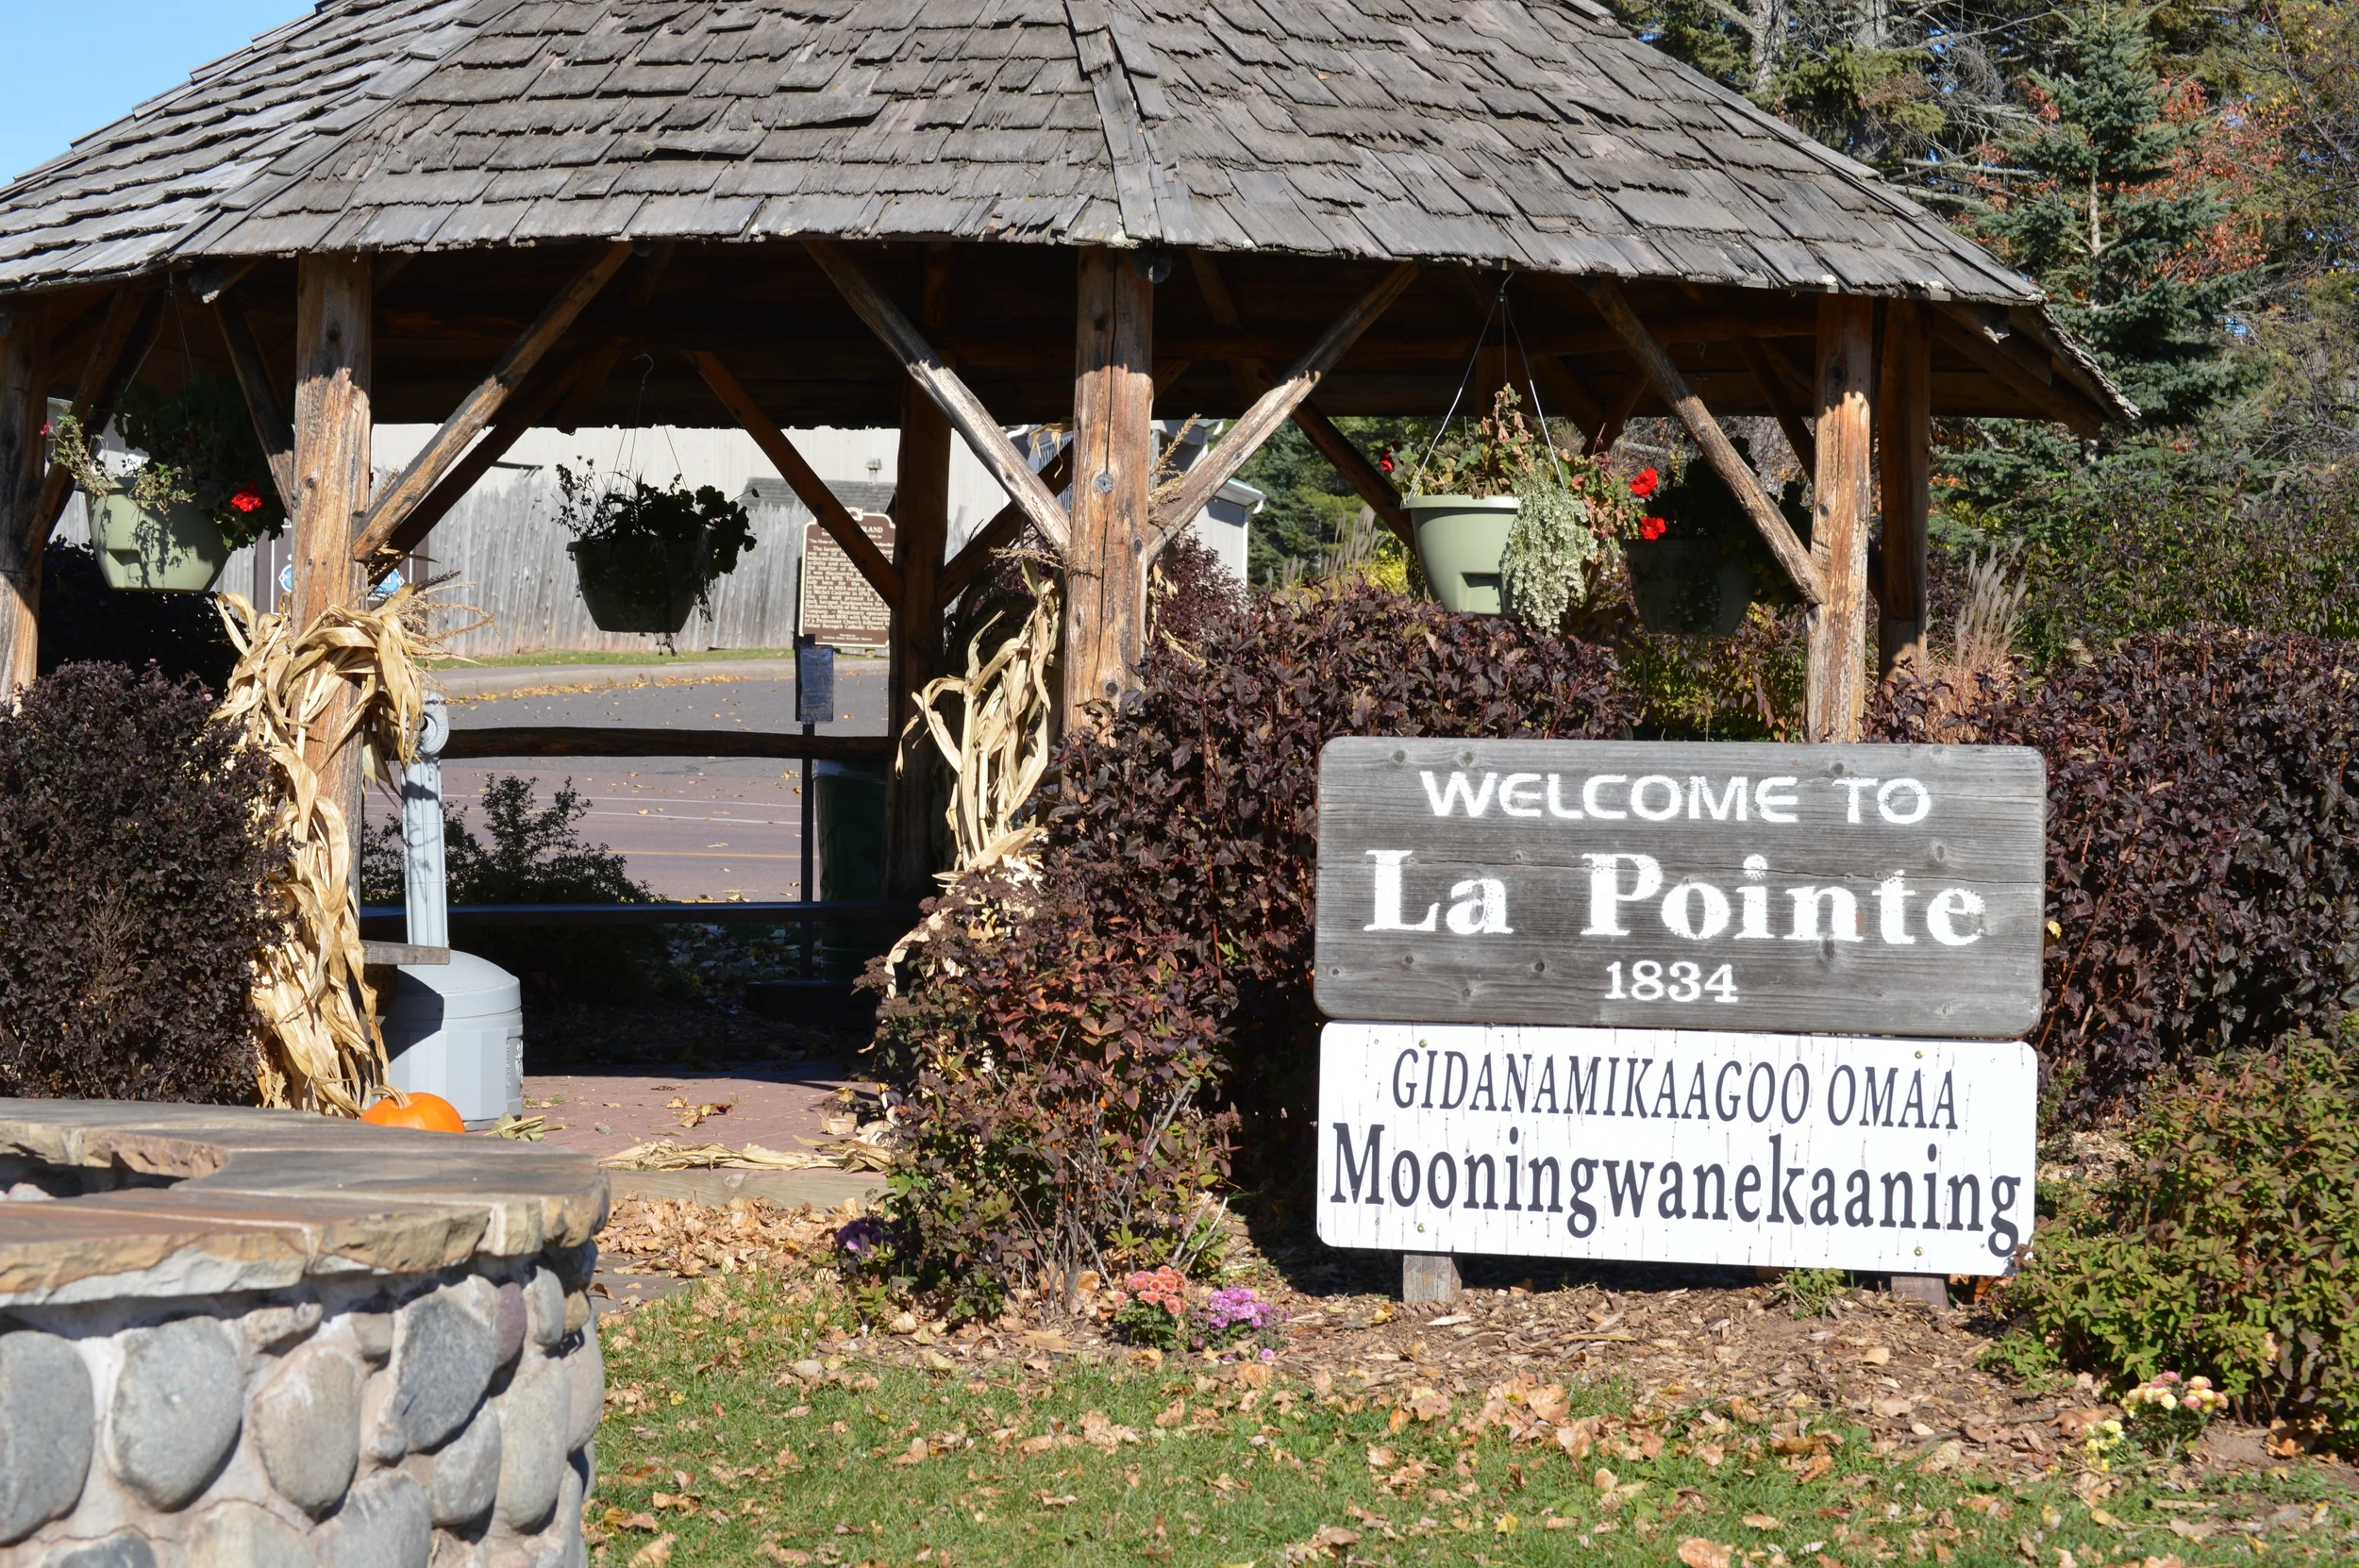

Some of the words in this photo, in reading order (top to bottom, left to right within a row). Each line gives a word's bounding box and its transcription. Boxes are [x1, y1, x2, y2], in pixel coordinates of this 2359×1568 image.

[1420, 772, 1798, 822] WELCOME
[1832, 777, 1931, 824] TO
[1364, 850, 1513, 934] La
[1581, 854, 1985, 945] Pointe
[1605, 961, 1738, 1002] 1834
[1394, 1049, 1809, 1124] GIDANAMIKAAGOO
[1829, 1065, 1957, 1129] OMAA
[1330, 1123, 2021, 1258] Mooningwanekaaning
